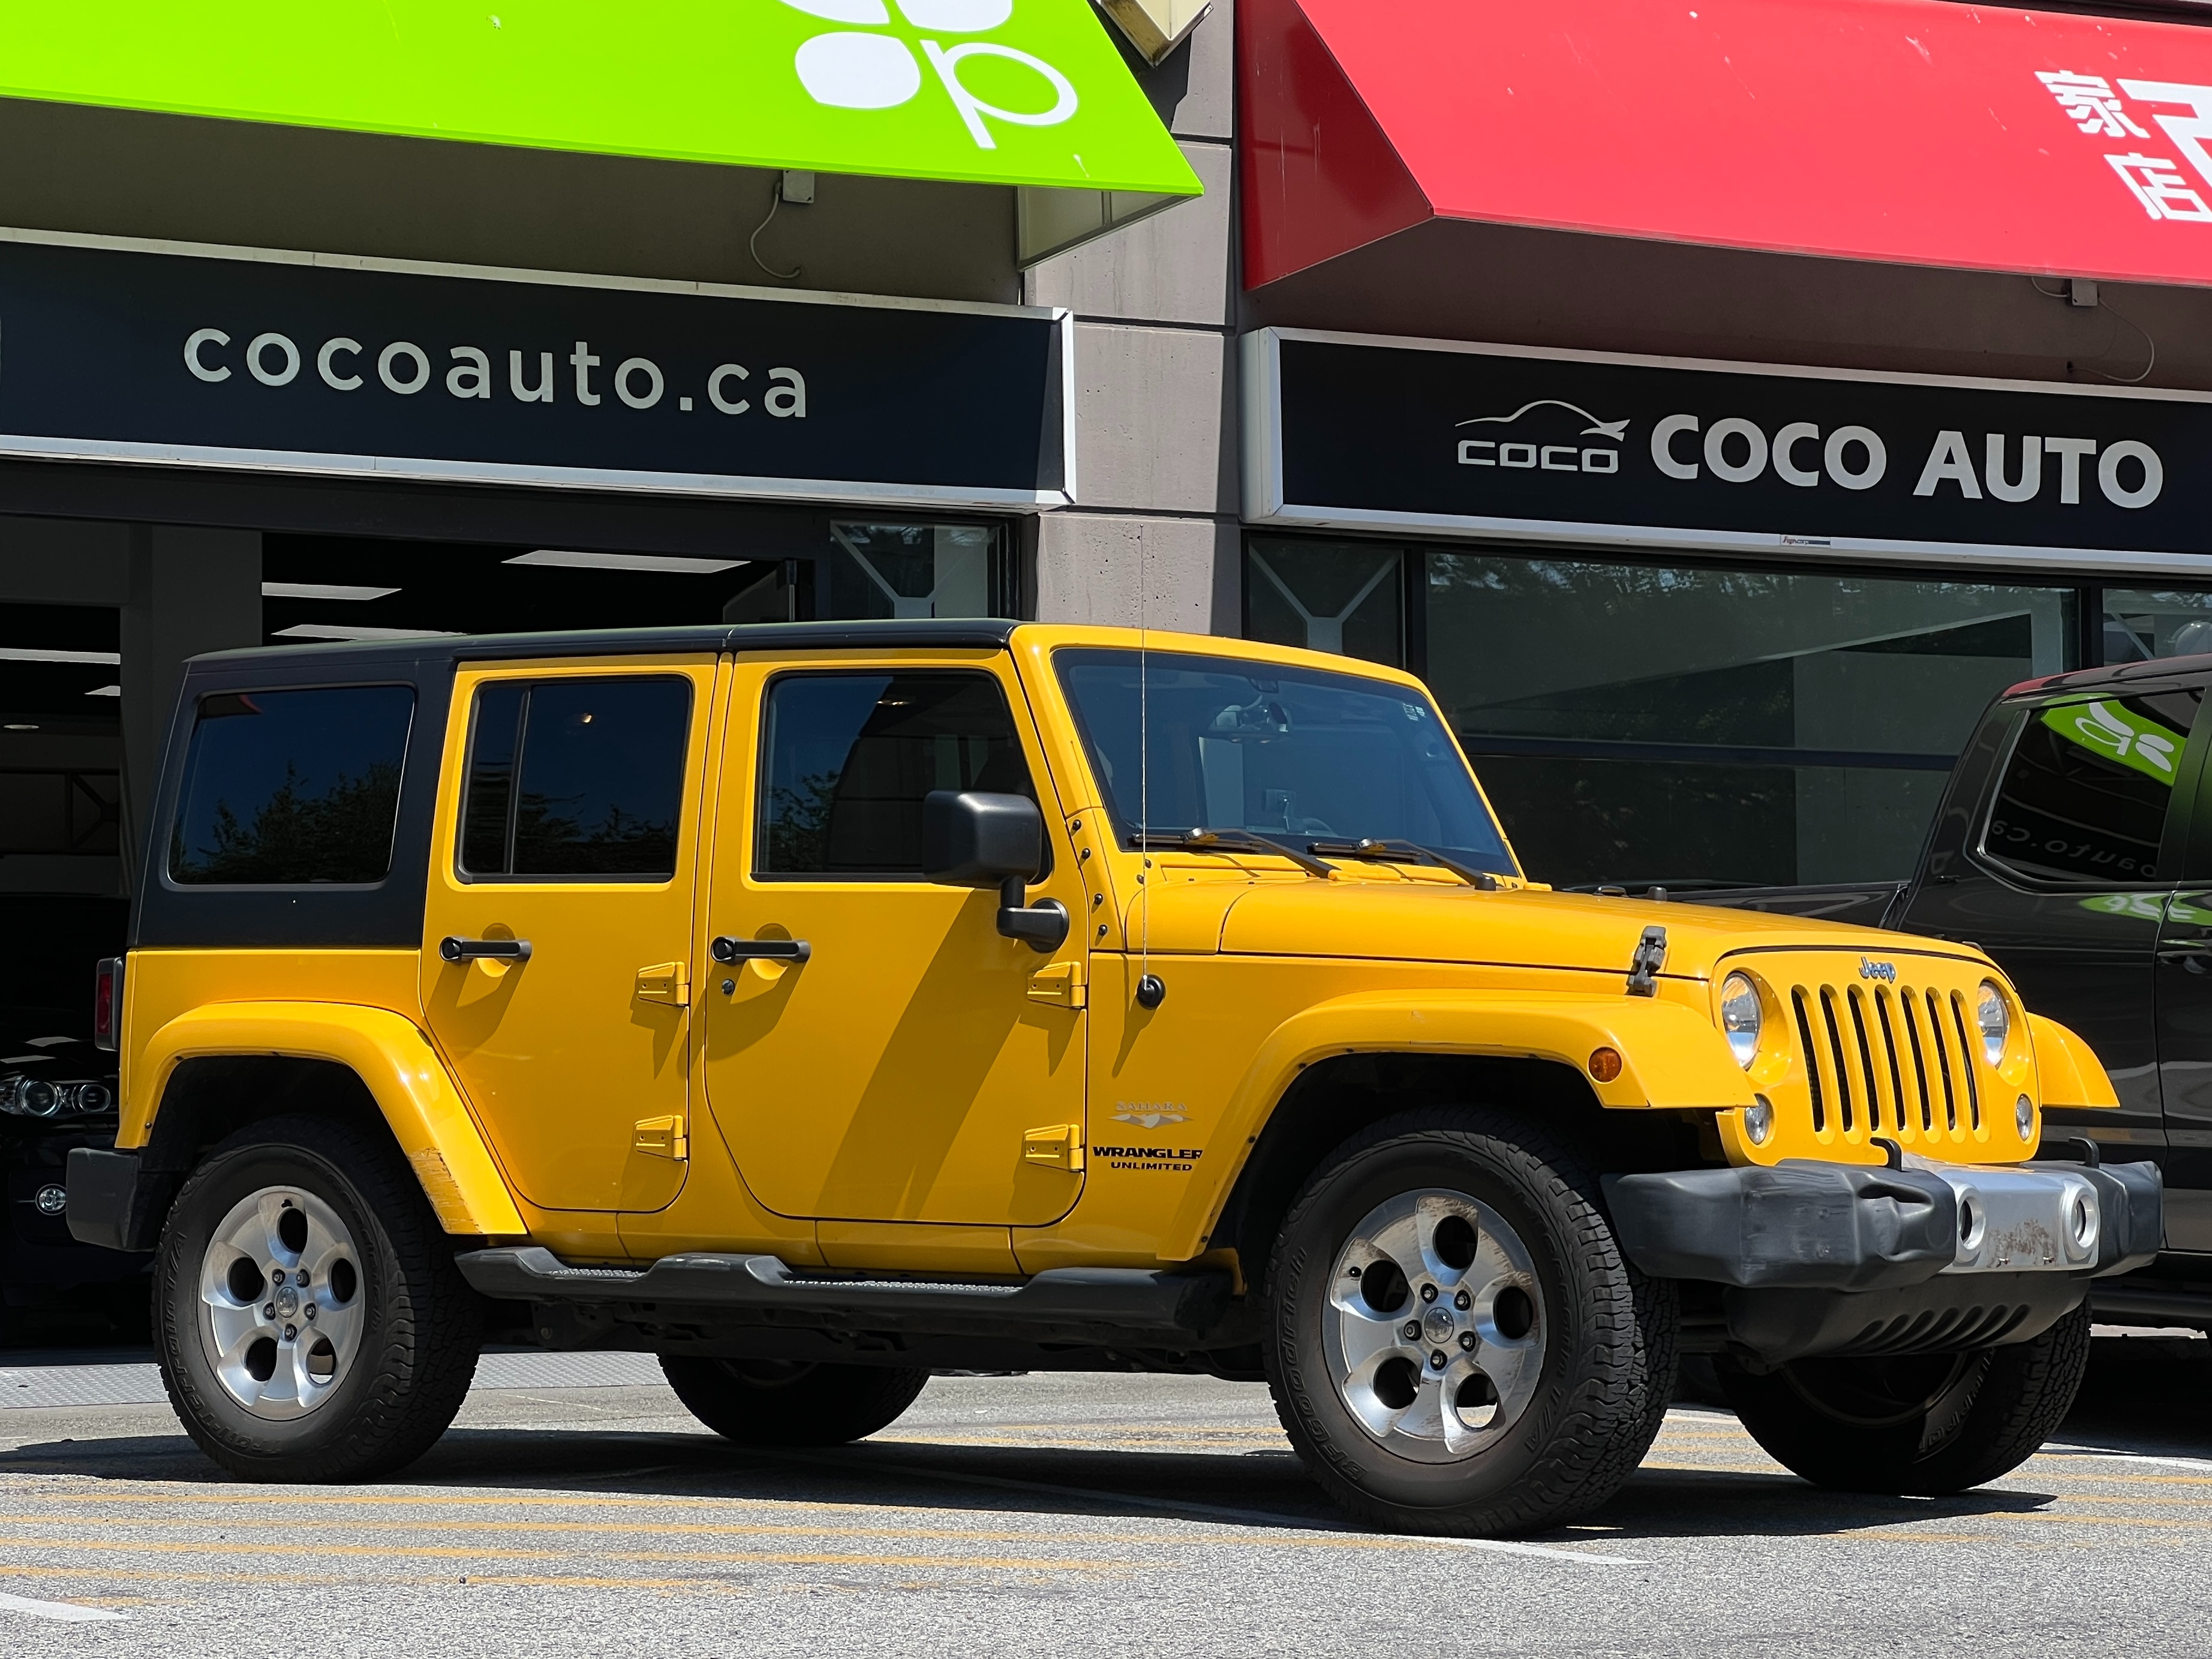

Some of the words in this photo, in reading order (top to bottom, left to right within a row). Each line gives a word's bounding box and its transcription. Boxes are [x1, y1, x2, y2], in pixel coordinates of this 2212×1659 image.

[184, 327, 807, 418] cocoauto.ca
[1650, 413, 1888, 491] COCO
[1912, 430, 2164, 509] AUTO
[1858, 956, 1897, 984] Jeep
[1116, 1101, 1188, 1111] SAHARA
[1092, 1146, 1203, 1160] WRANGLER
[1110, 1161, 1192, 1171] UNLIMITED
[1282, 1247, 1369, 1482] BFGoodrich
